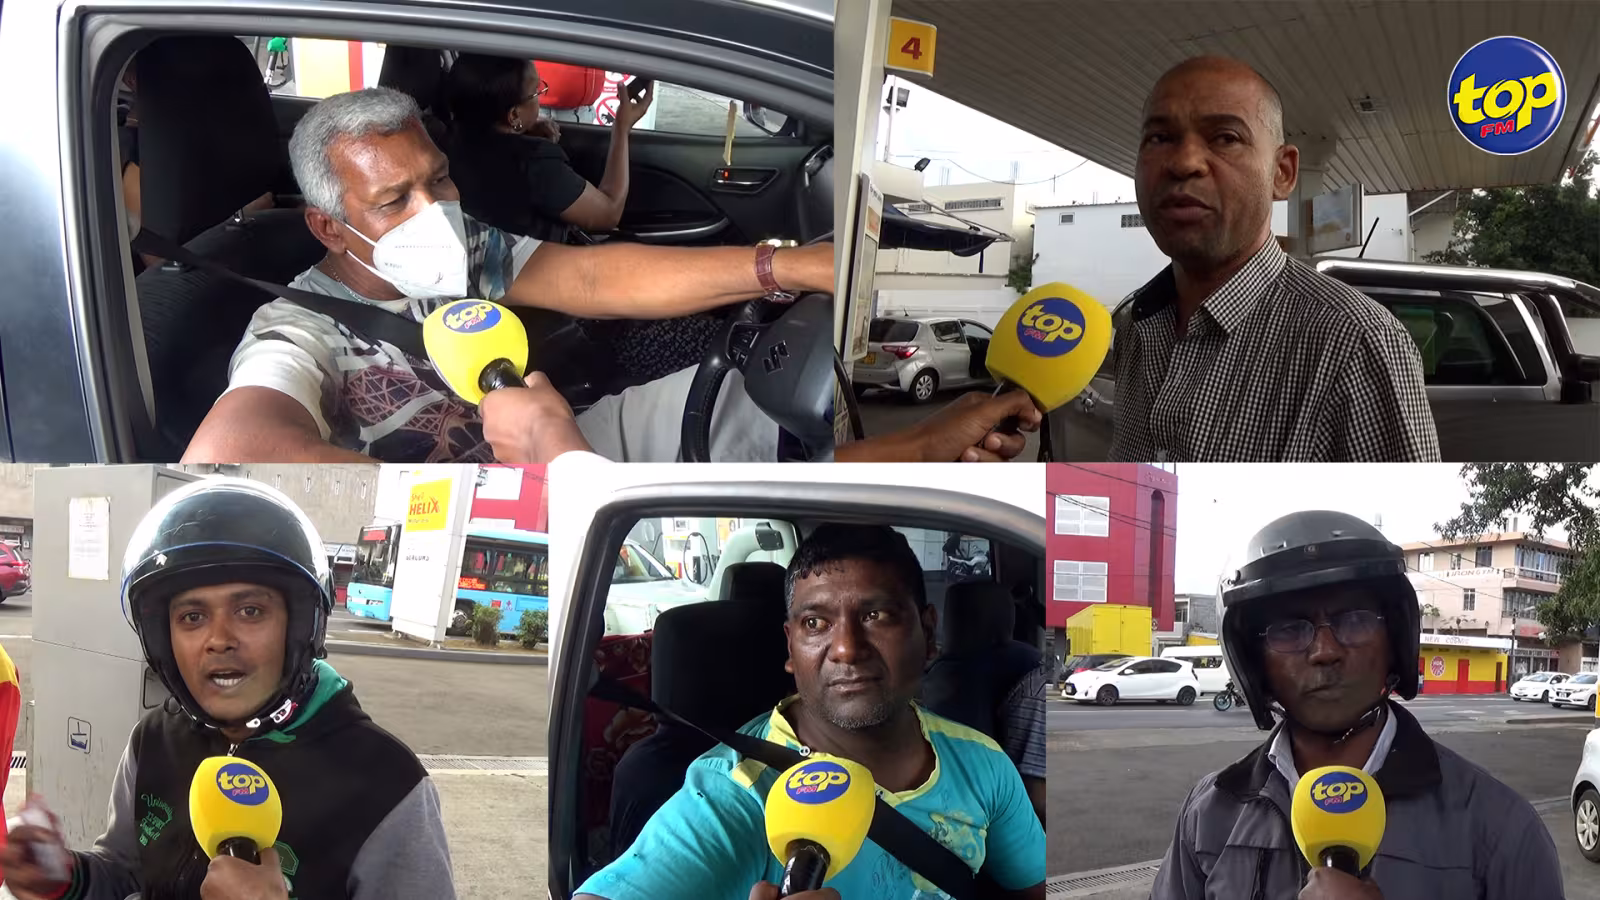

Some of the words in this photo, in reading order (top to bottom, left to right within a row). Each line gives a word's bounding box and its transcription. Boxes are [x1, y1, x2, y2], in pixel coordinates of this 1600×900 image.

[901, 36, 923, 60] 4
[446, 303, 492, 329] top
[1021, 305, 1083, 342] top
[409, 497, 440, 515] HELIX
[218, 771, 266, 795] top
[788, 770, 849, 792] top
[1312, 781, 1365, 803] top
